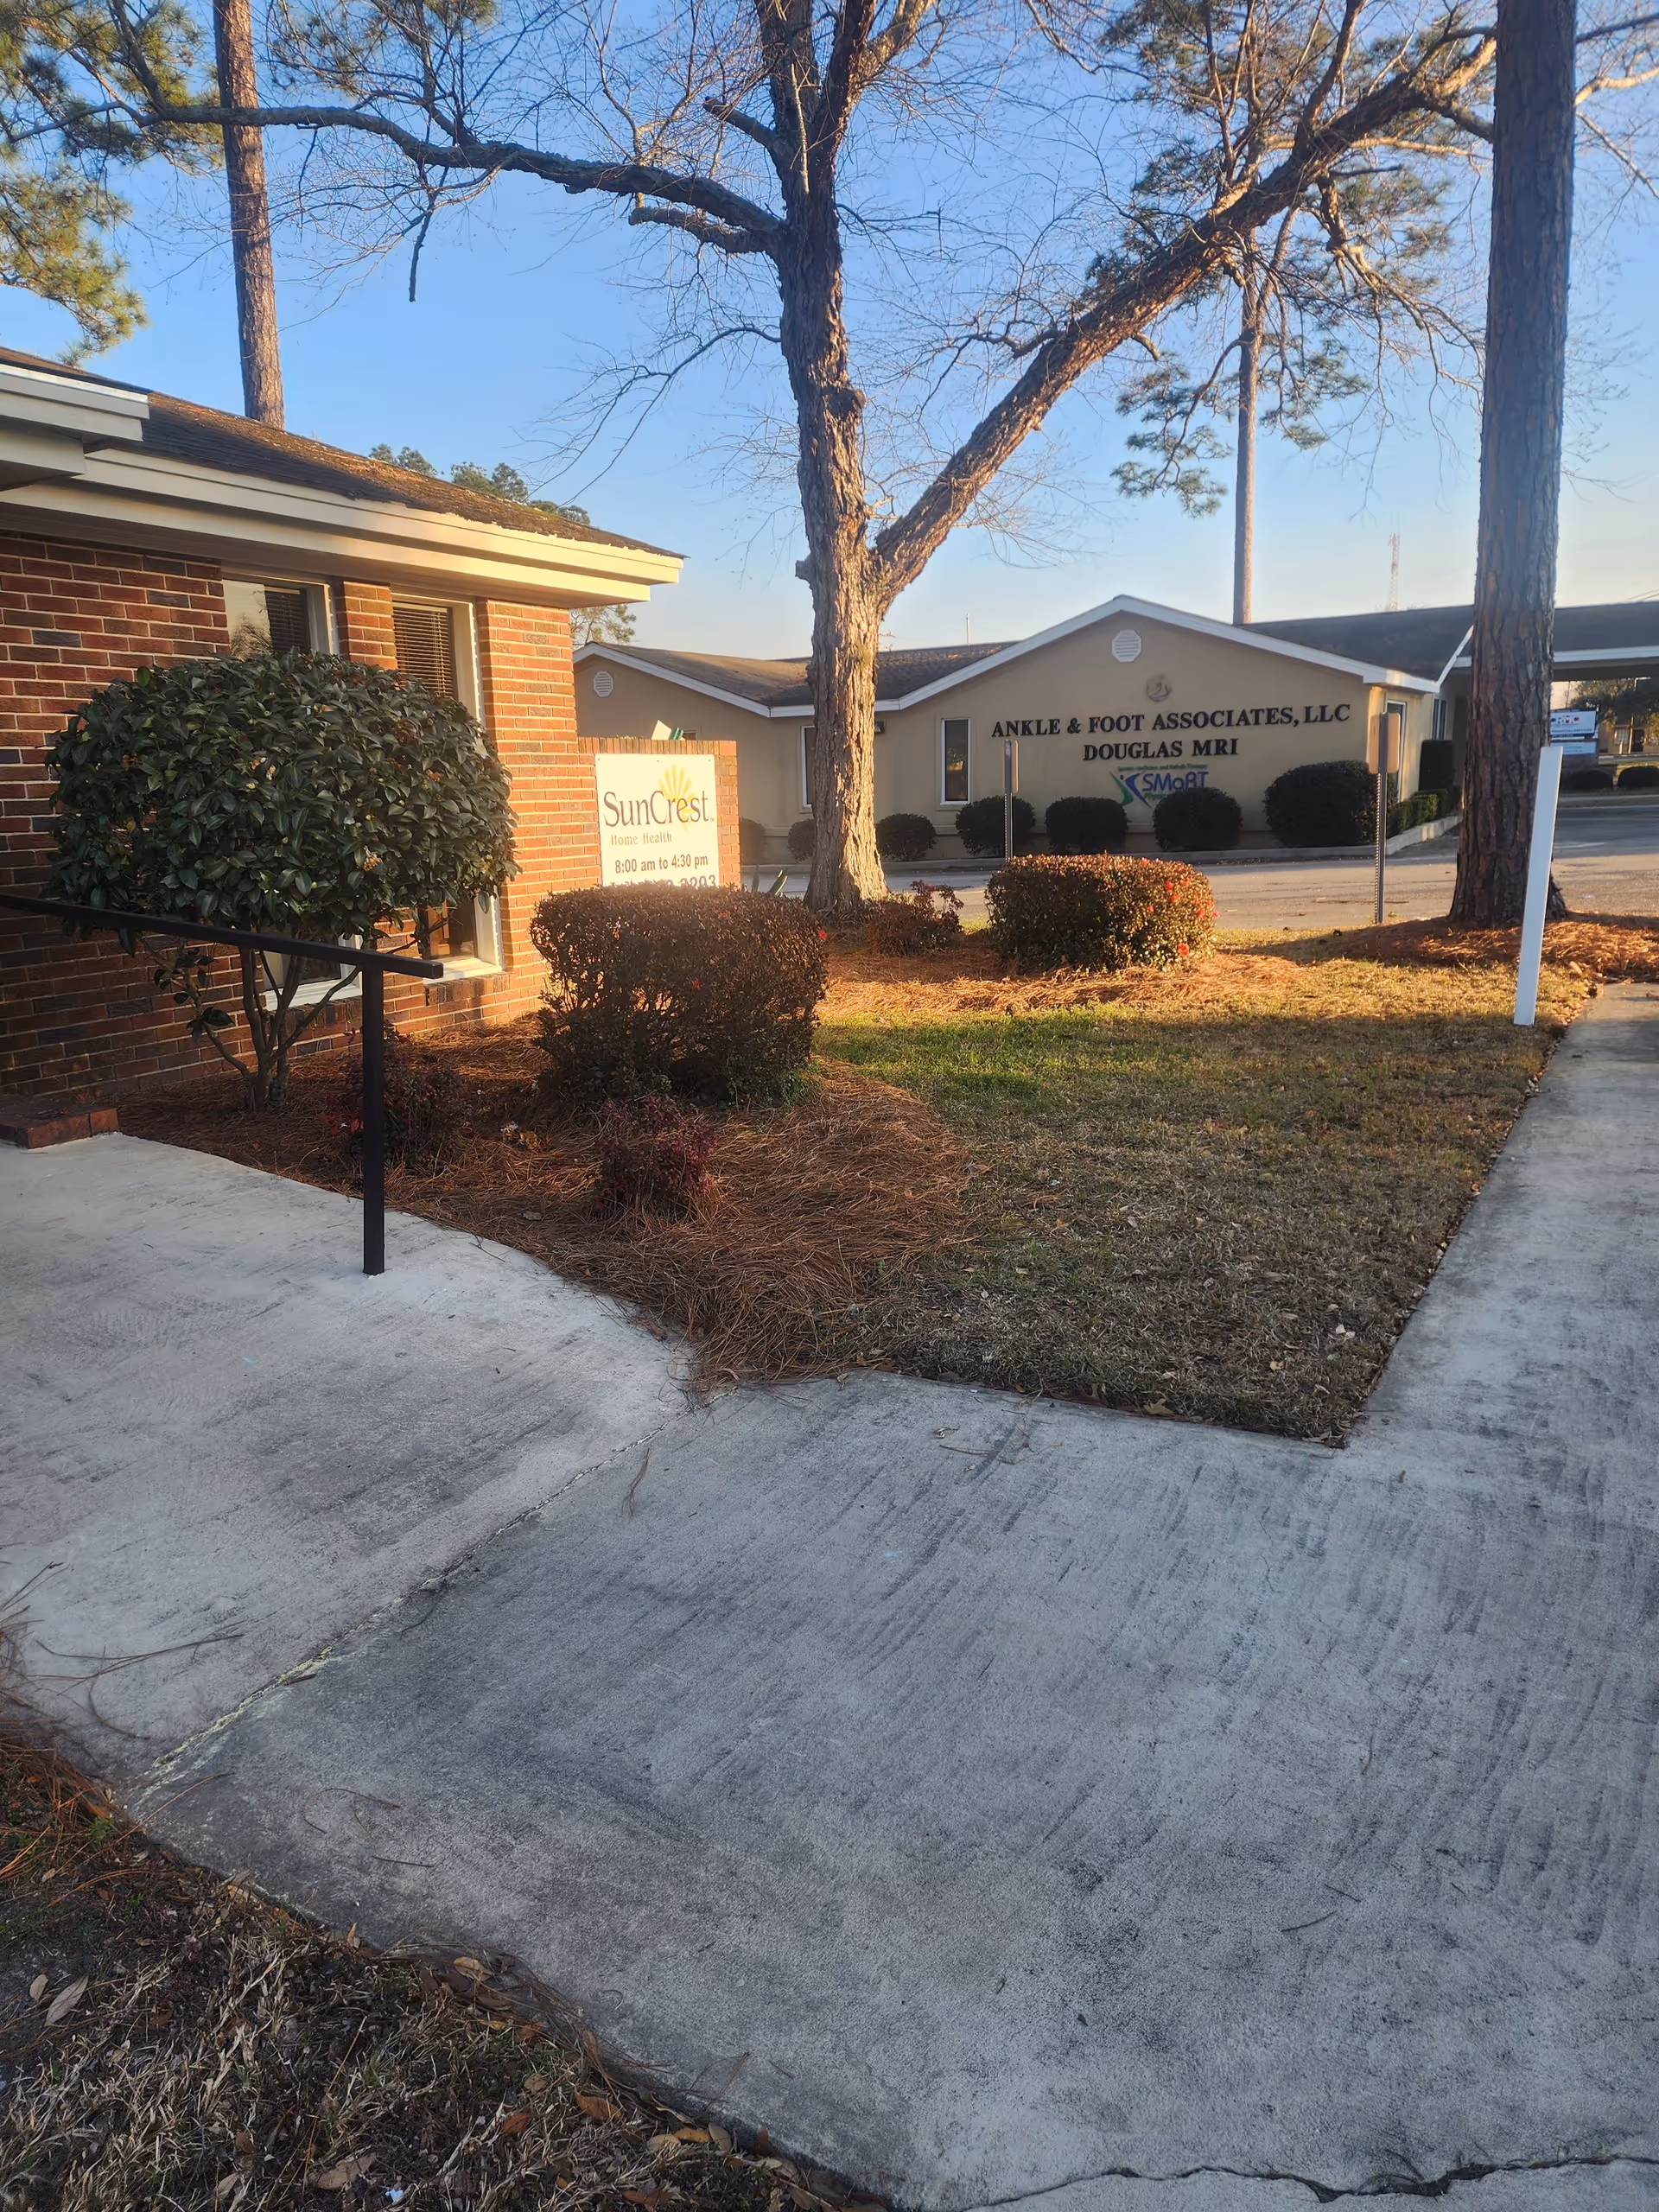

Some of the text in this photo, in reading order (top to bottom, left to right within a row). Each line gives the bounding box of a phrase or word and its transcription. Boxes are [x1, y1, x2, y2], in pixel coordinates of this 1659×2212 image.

[991, 718, 1061, 737] ANKLE
[1066, 716, 1082, 734] &
[1088, 714, 1145, 733] FOOT
[1083, 738, 1239, 761] DOUGLAS MRI
[603, 790, 709, 827] SunCrest
[611, 830, 672, 846] Home Health
[614, 853, 709, 874] 8:00 am to 4:30 pm
